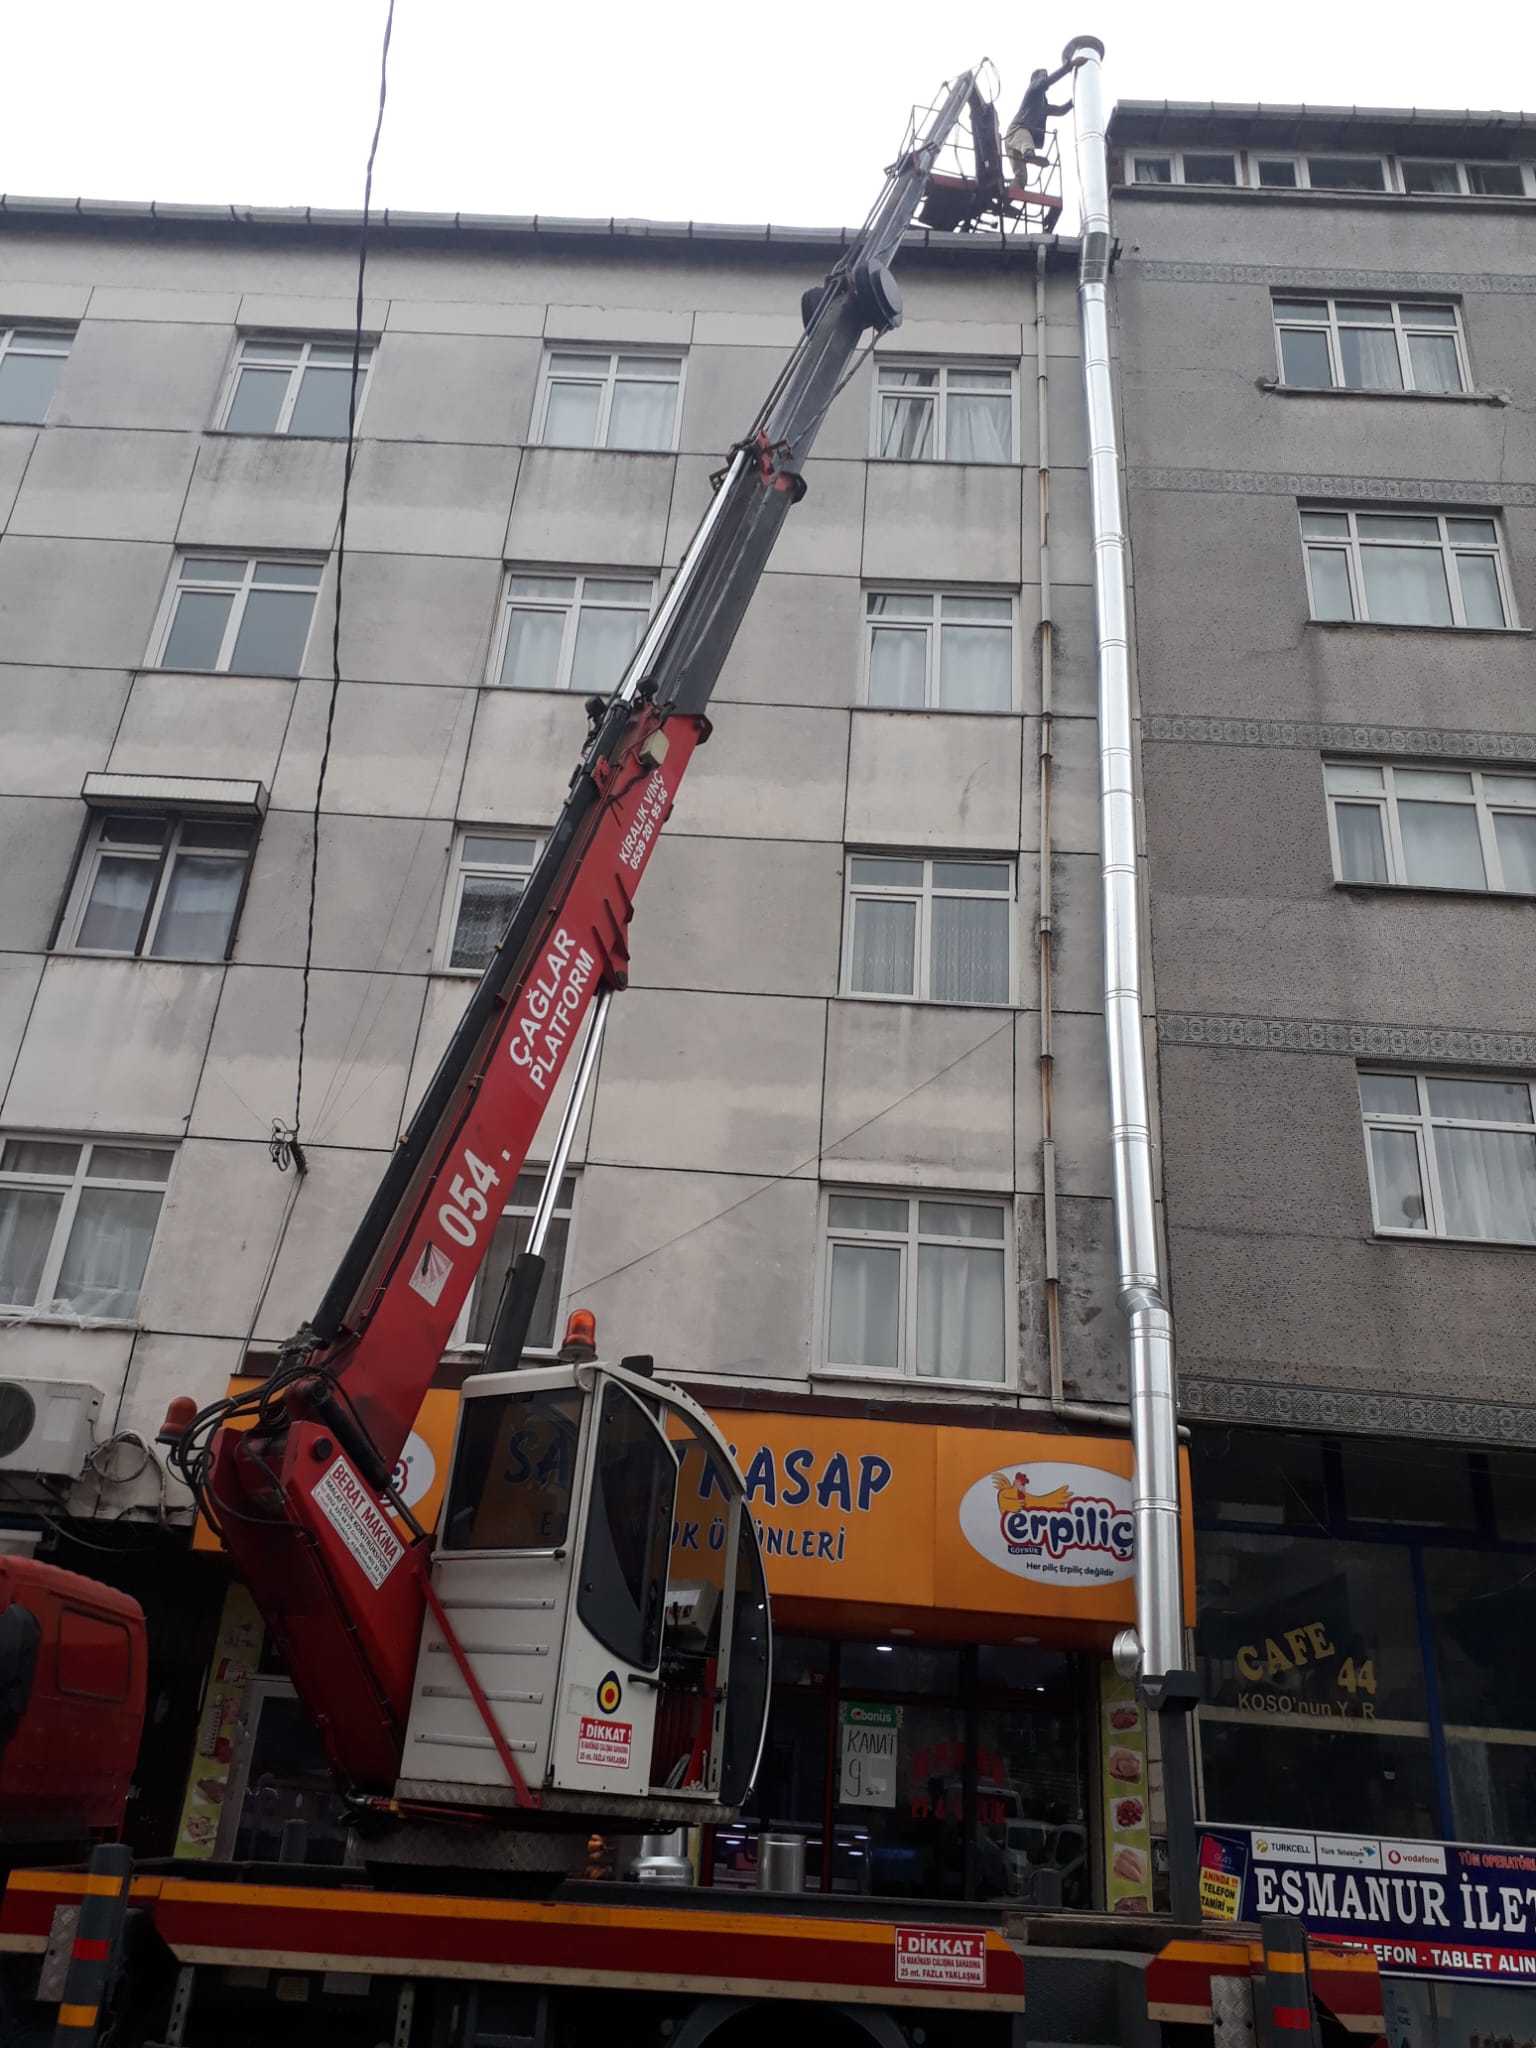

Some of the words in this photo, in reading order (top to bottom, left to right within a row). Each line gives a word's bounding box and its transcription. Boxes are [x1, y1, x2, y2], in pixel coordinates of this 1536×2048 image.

[630, 840, 646, 870] 0539
[642, 818, 655, 842] 201
[651, 803, 661, 820] 95
[658, 787, 668, 804] 56
[509, 928, 576, 1068] ÇAĞLAR
[529, 947, 595, 1090] PLATFORM
[332, 1462, 366, 1512] BERAT
[360, 1505, 399, 1562] MAKİNA
[1008, 1507, 1134, 1557] erpiliç
[1026, 1562, 1041, 1570] Her
[1042, 1563, 1058, 1574] piliç
[1059, 1565, 1083, 1576] Erpiliç
[1084, 1567, 1115, 1578] değildir
[1236, 1621, 1336, 1681] CAFE
[1337, 1657, 1377, 1694] 44
[586, 1720, 627, 1742] DİKKAT
[1271, 1842, 1311, 1854] TURKCELL
[1402, 1854, 1440, 1866] vodafone
[1202, 1871, 1231, 1885] ANINDA
[1203, 1882, 1236, 1900] TELEFON
[1253, 1866, 1450, 1928] ESMANUR
[1200, 1896, 1226, 1911] TAMİRİ
[908, 1933, 974, 1956] DİKKAT
[1430, 1949, 1493, 1970] TABLET
[901, 1968, 909, 1977] 25
[922, 1969, 945, 1979] FAZLA
[944, 1971, 981, 1982] YAKLAŞMA
